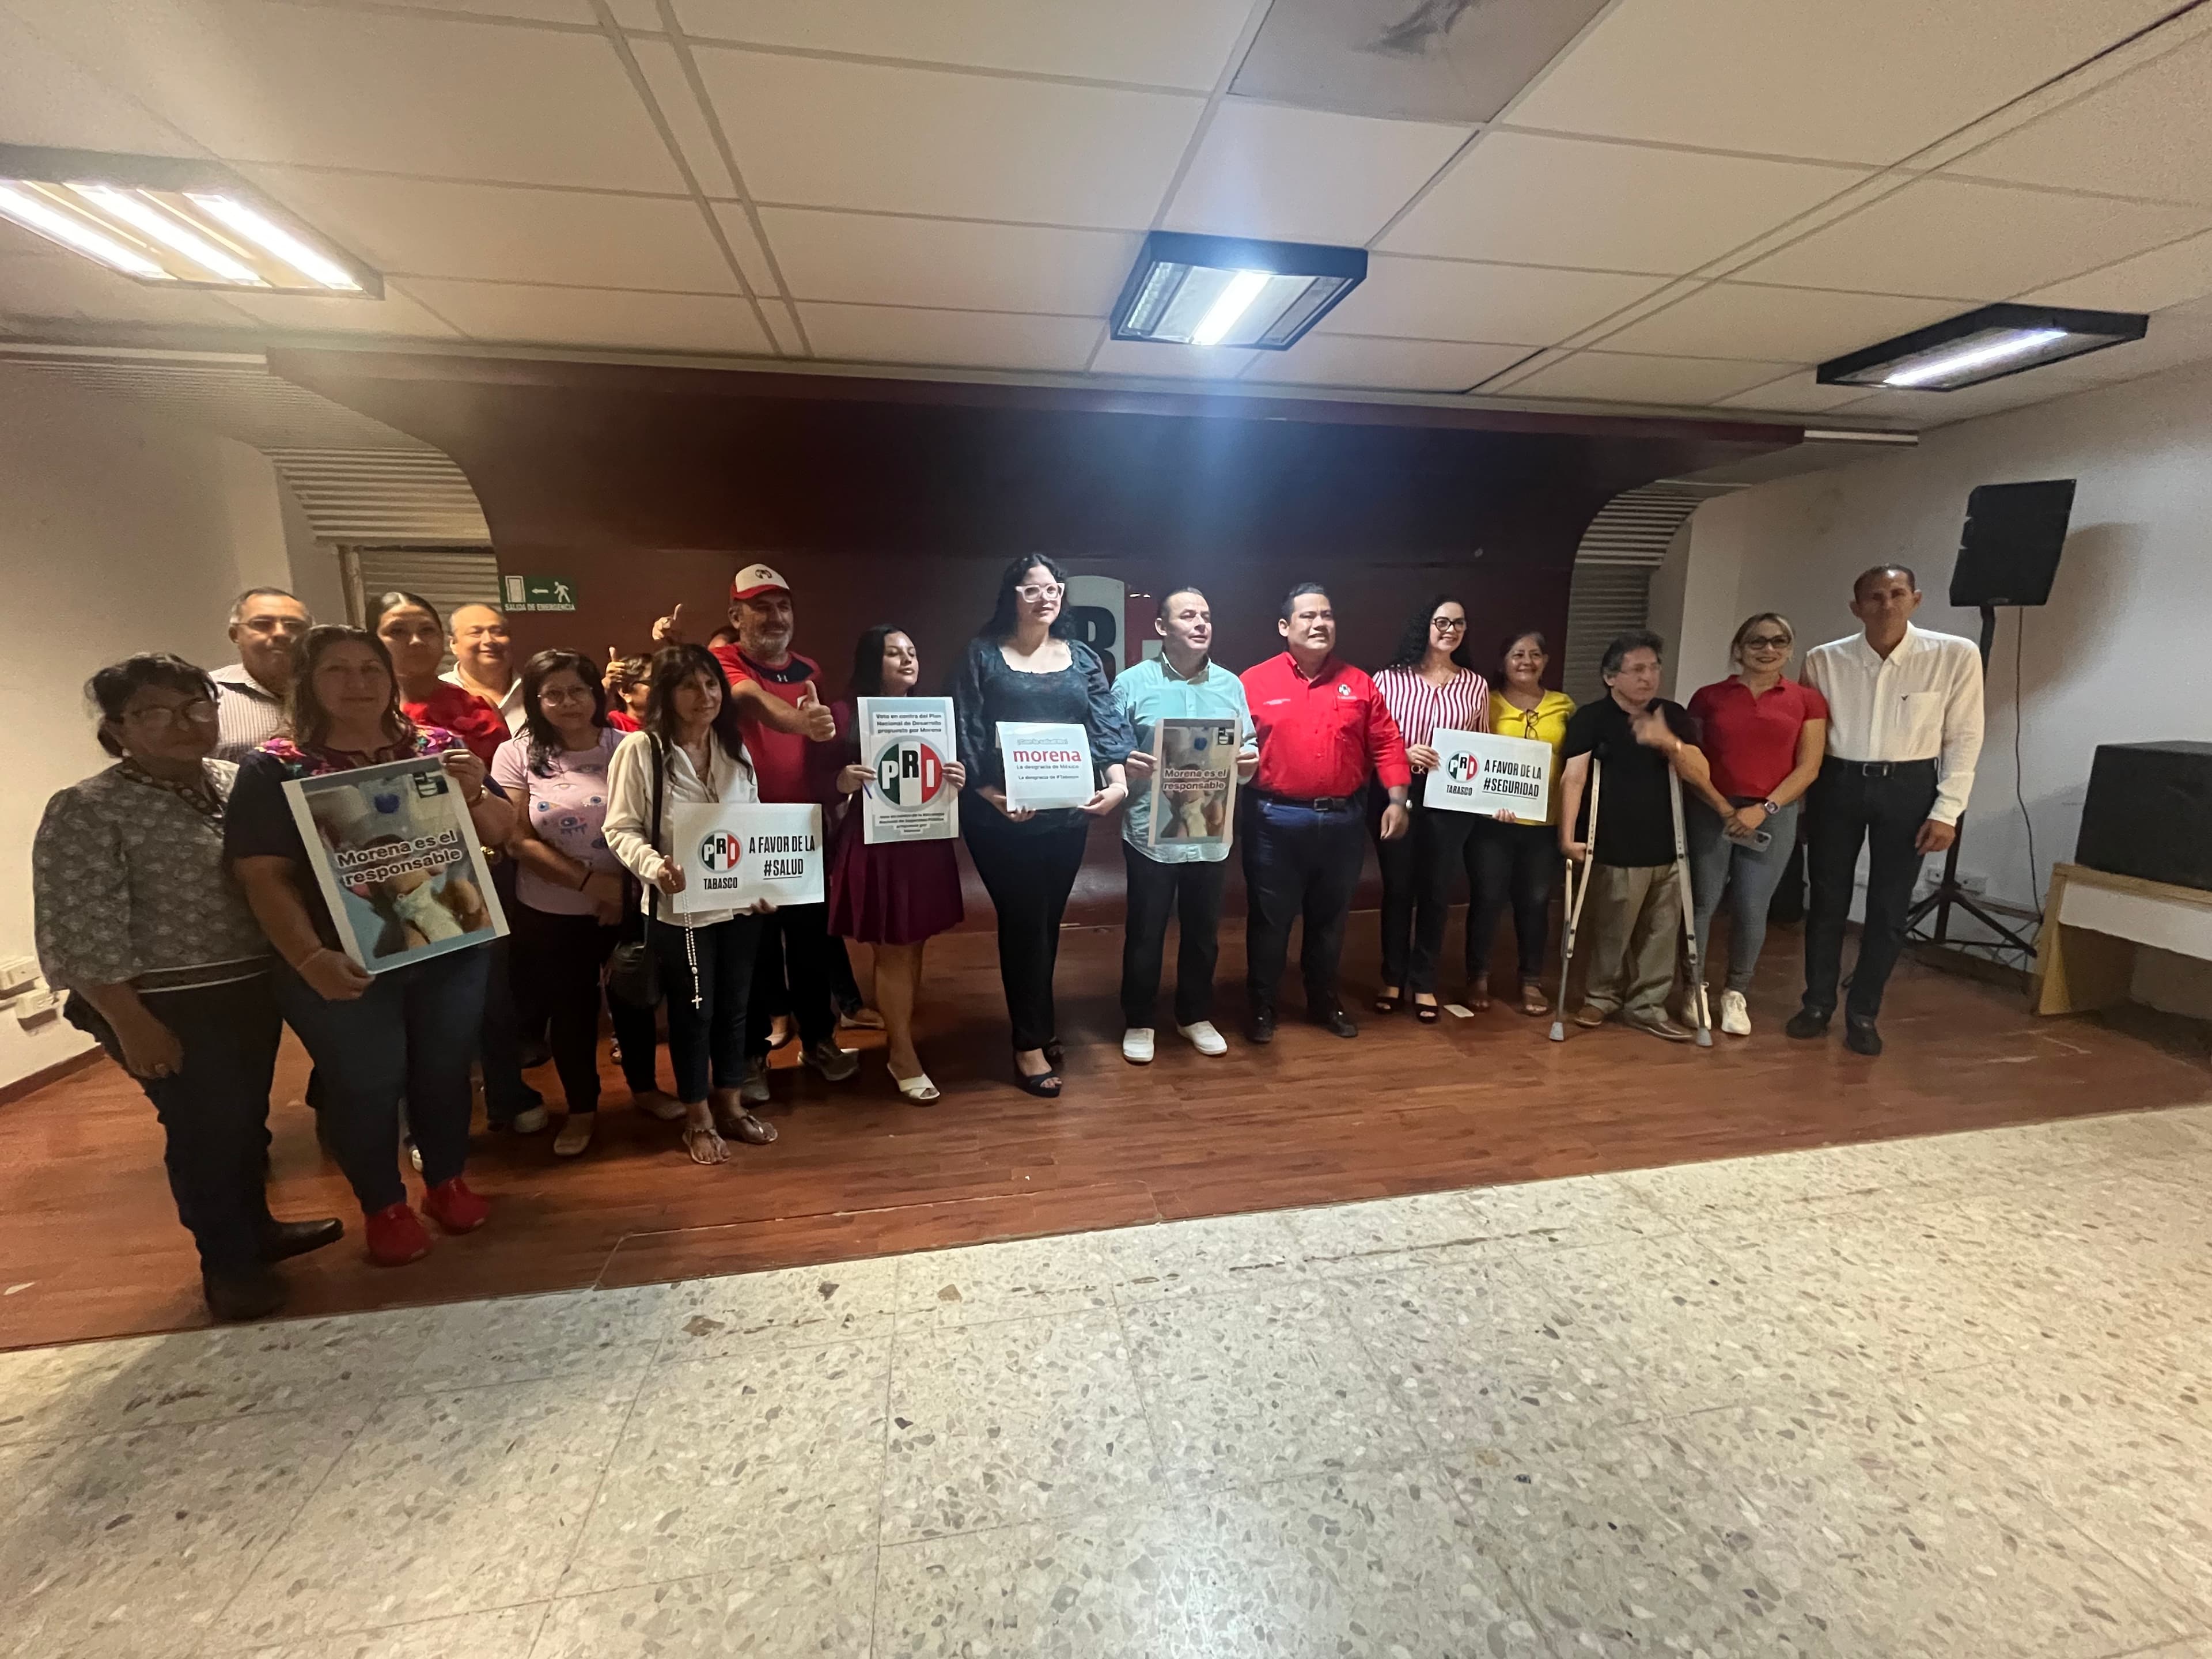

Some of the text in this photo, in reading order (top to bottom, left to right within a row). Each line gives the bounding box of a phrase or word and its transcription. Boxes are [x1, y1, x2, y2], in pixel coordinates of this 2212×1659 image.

[1013, 751, 1081, 762] morena
[1449, 757, 1475, 775] PRI
[881, 750, 935, 790] PRI
[1164, 769, 1202, 778] Morena
[1217, 768, 1226, 777] el
[1484, 759, 1541, 779] A FAVOR DE LA
[1164, 782, 1225, 791] responsable
[1446, 785, 1472, 796] TABASCO
[1483, 778, 1539, 797] #SEGURIDAD
[338, 830, 457, 866] Morena es el
[703, 838, 736, 861] PRI
[749, 835, 815, 854] A FAVOR DE LA
[345, 849, 461, 885] responsable
[764, 858, 804, 877] #SALUD
[703, 877, 738, 890] TABASCO
